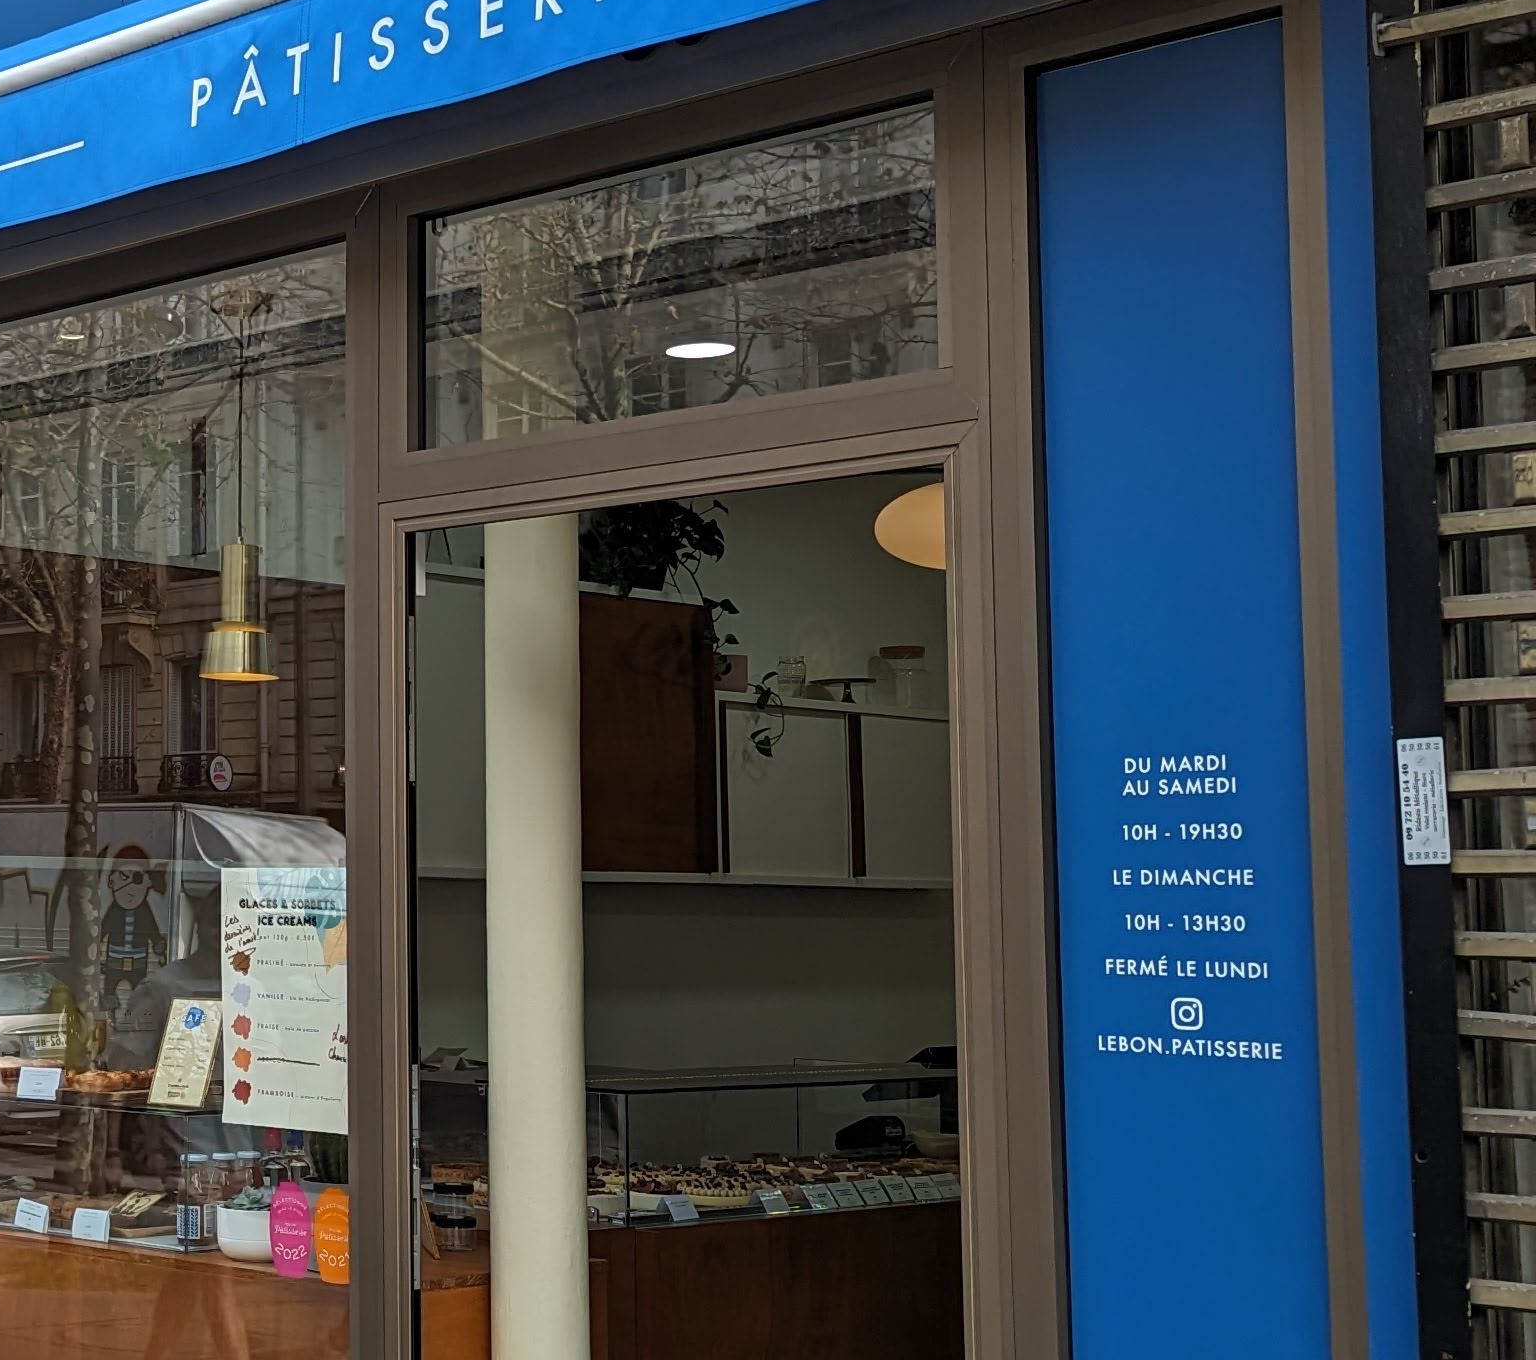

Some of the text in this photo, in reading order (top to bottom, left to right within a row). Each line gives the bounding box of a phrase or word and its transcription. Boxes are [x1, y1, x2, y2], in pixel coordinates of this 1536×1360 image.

[1124, 754, 1228, 774] DU MARDI
[1122, 776, 1238, 797] AU SAMEDI
[1121, 824, 1158, 841] 10H
[1178, 822, 1243, 840] 19H30
[1112, 868, 1255, 887] LE DIMANCHE
[238, 898, 278, 910] GLACES
[290, 898, 336, 911] SORBETS
[257, 915, 318, 927] ICE CREAMS
[1124, 913, 1161, 931] 10H
[1182, 914, 1247, 933] 13H30
[1104, 954, 1269, 979] FERMÉ LE LUNDI
[1097, 1034, 1284, 1061] LEBON.PATISSERIE
[274, 1242, 308, 1260] 2022
